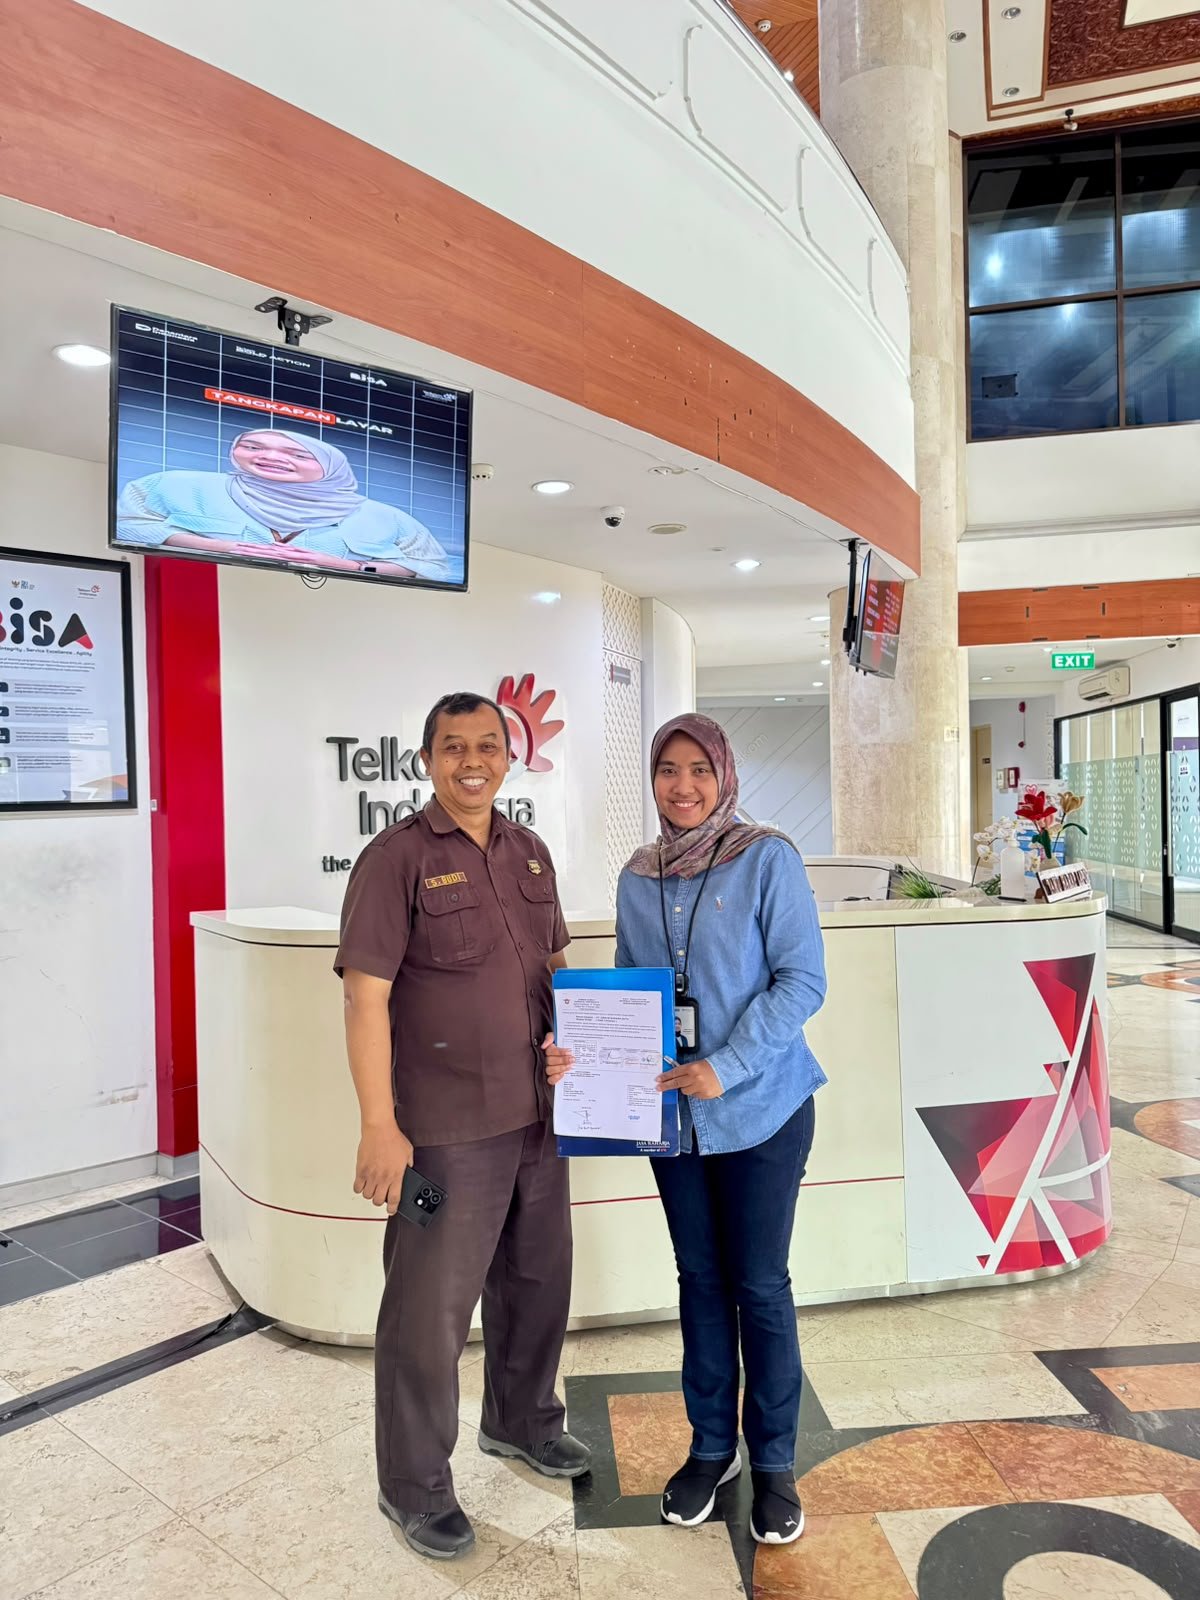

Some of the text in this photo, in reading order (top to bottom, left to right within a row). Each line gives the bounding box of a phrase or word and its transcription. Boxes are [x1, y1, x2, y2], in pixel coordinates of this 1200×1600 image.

[211, 391, 393, 435] TANGKAPAN LAYAR
[1054, 655, 1091, 667] EXIT
[326, 736, 432, 782] Telk
[321, 855, 352, 872] the
